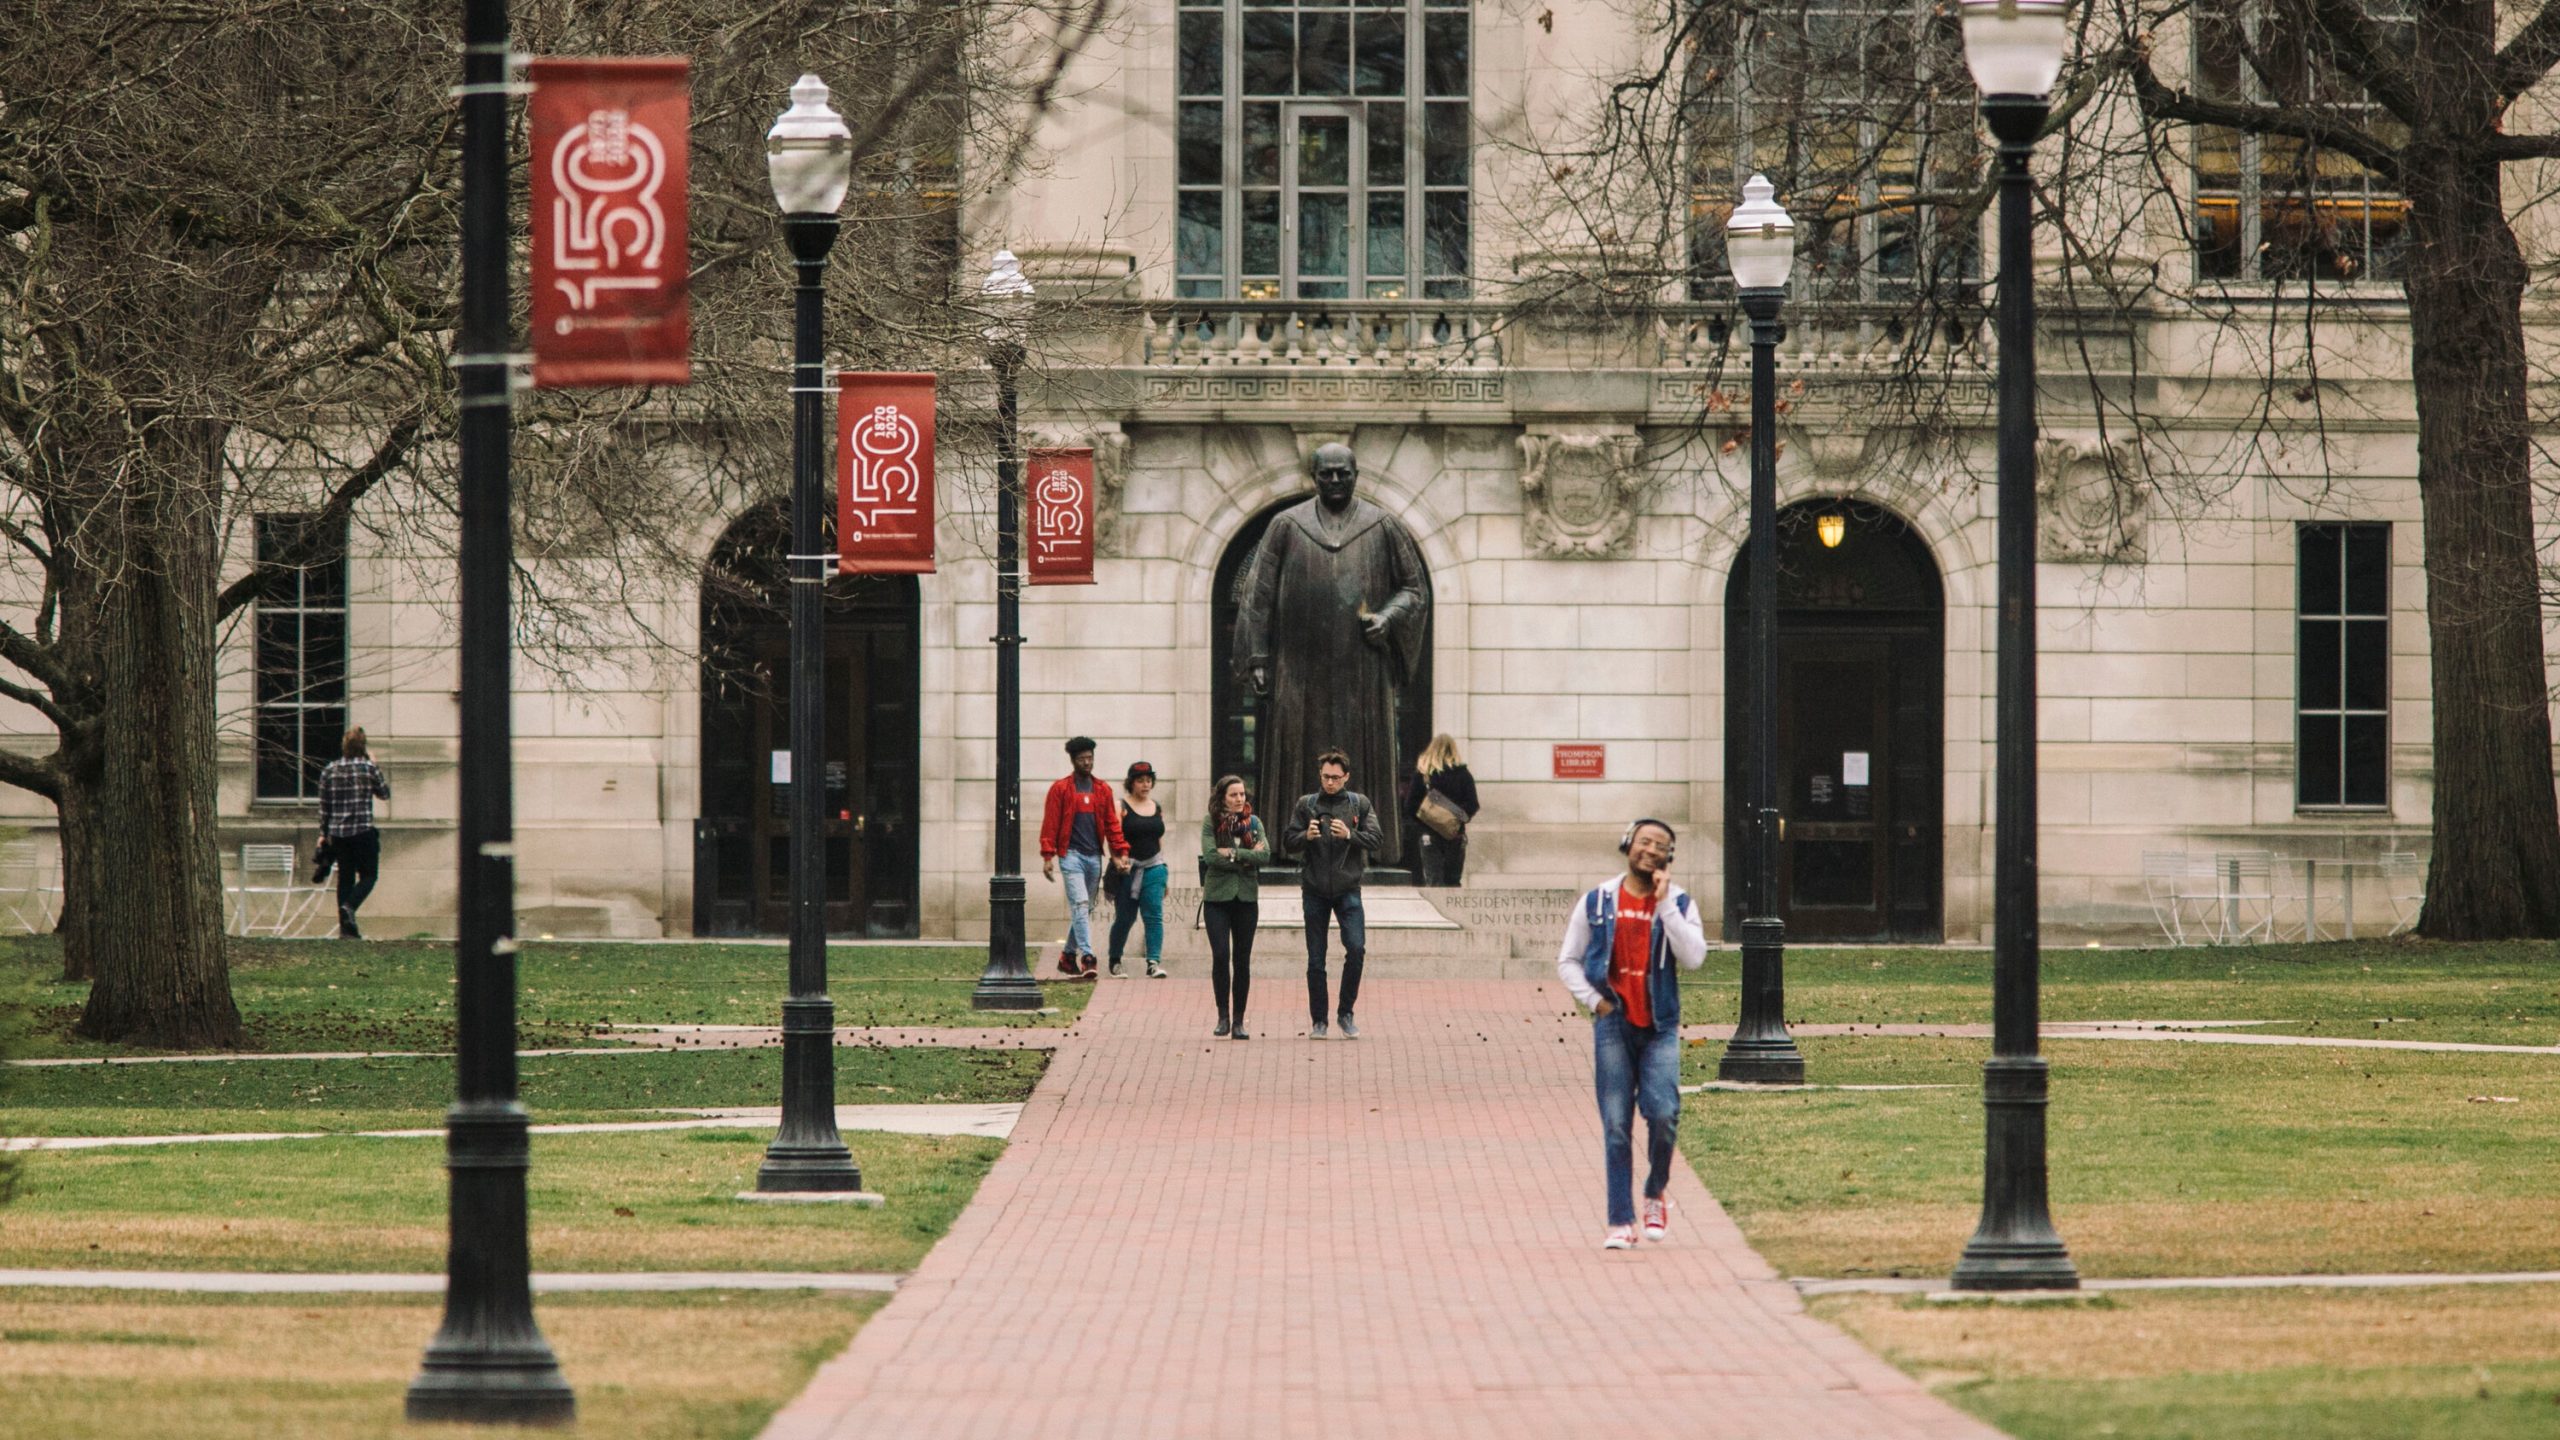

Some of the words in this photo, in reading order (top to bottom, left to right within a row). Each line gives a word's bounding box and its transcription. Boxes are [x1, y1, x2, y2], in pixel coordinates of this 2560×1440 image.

[552, 121, 666, 310] 150
[874, 406, 886, 438] 1870
[886, 405, 898, 439] 2020
[852, 414, 920, 526] 150
[1036, 475, 1083, 552] 150
[1556, 750, 1602, 758] THOMPSON
[1561, 759, 1597, 767] LIBRARY
[1446, 896, 1518, 909] PRESIDENT
[1541, 896, 1569, 909] THIS
[1471, 913, 1569, 926] UNIVERSITY
